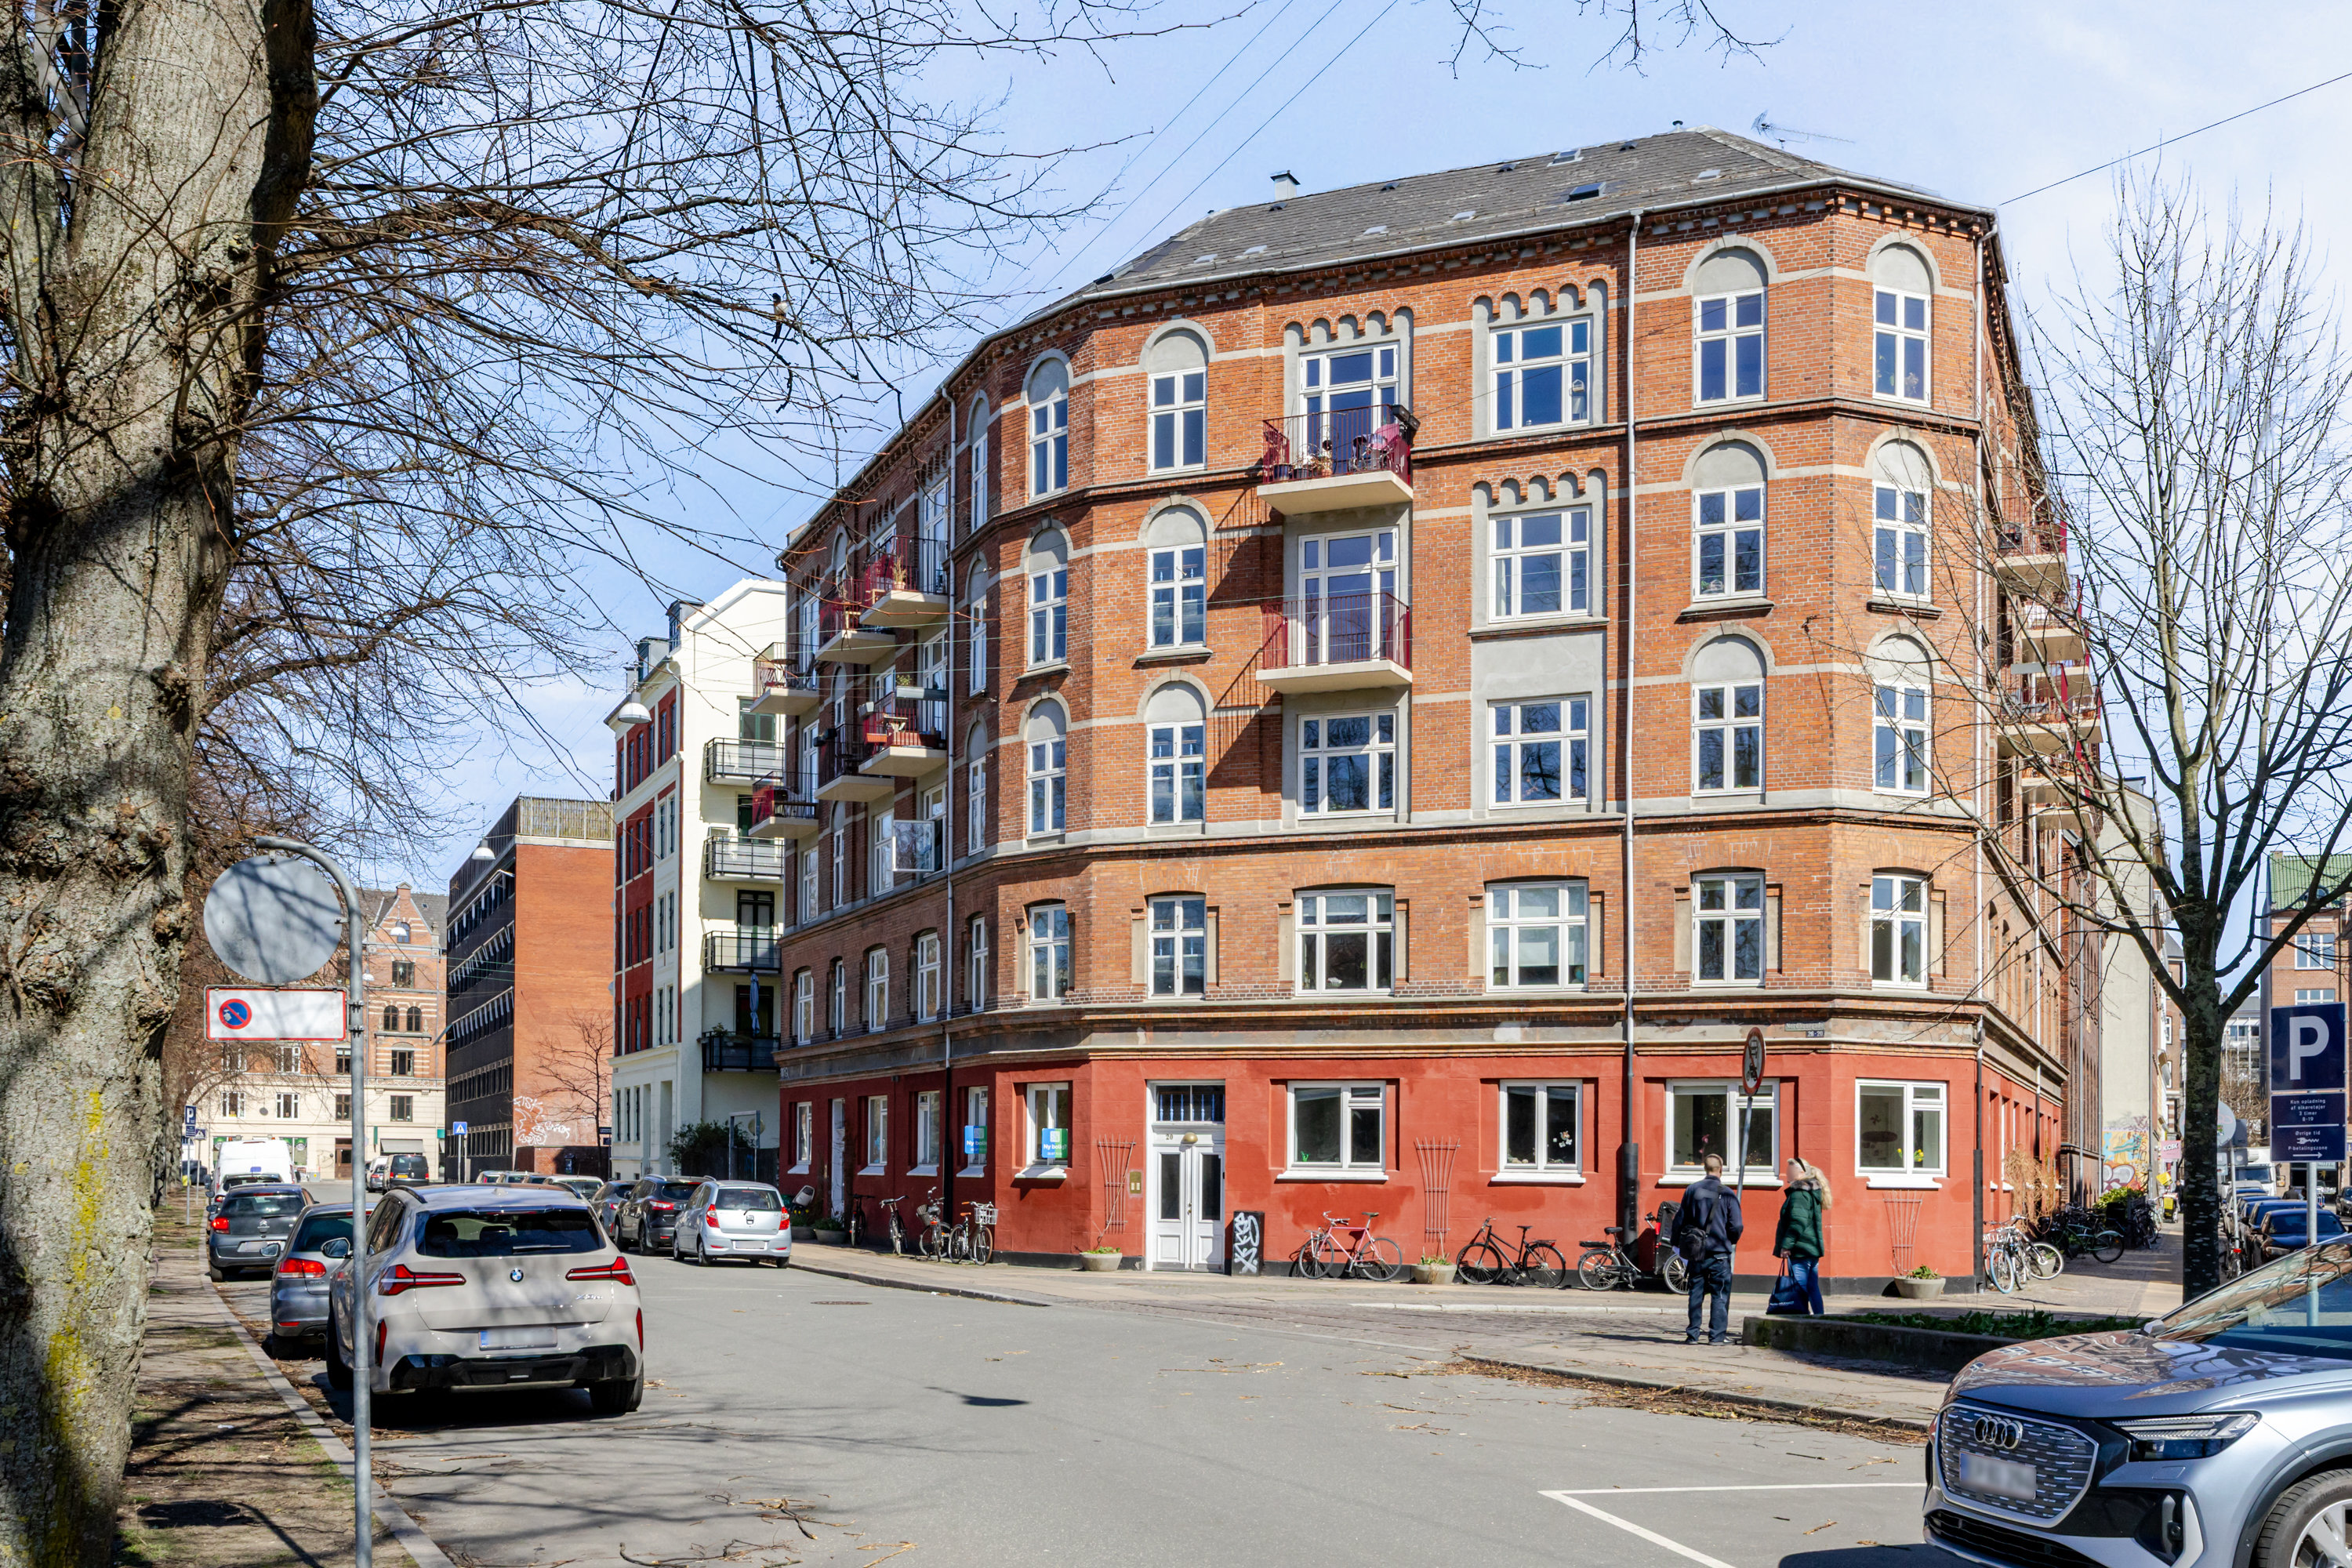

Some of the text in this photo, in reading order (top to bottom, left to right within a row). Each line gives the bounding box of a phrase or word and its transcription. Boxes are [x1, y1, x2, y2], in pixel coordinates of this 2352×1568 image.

[2288, 1015, 2330, 1080] P
[187, 1107, 194, 1123] P
[2163, 1142, 2180, 1152] KIOSK
